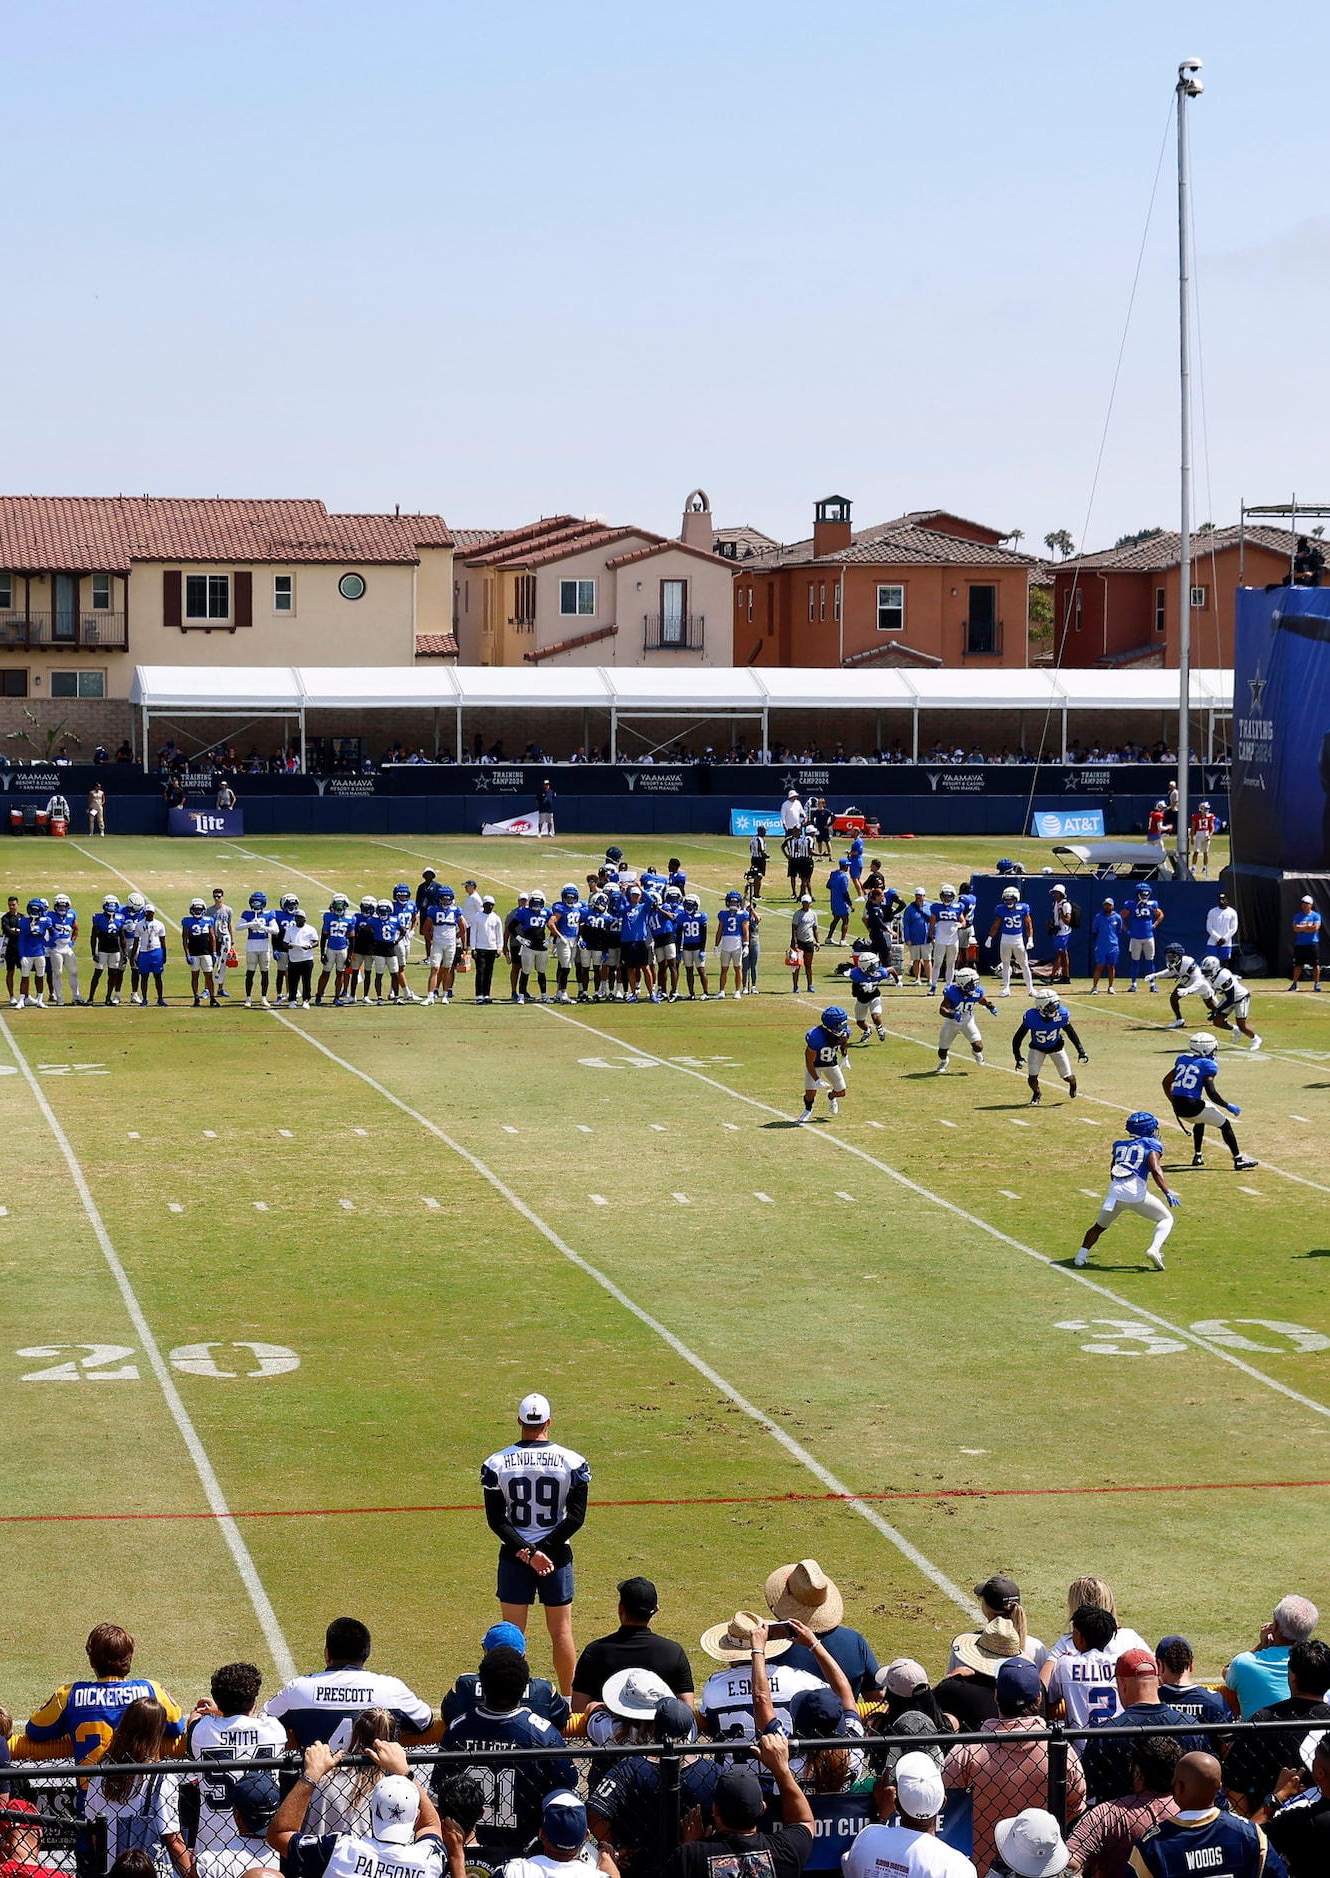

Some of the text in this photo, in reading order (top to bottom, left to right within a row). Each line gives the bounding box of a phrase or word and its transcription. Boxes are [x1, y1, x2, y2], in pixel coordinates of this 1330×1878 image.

[1239, 719, 1273, 740] TRAINING
[195, 816, 224, 834] Lite
[509, 822, 529, 833] WSS
[753, 818, 784, 829] invisal
[1064, 818, 1100, 831] AT&T
[1198, 819, 1208, 829] 13
[108, 924, 116, 933] 2
[330, 921, 348, 937] 25
[382, 925, 391, 940] 6
[683, 921, 700, 937] 38
[728, 917, 736, 932] 3
[1035, 1030, 1060, 1044] 54
[1173, 1064, 1199, 1090] 26
[17, 1342, 301, 1381] 20
[508, 1477, 560, 1528] 89
[1072, 1663, 1116, 1681] ELLIO
[316, 1686, 374, 1703] PRESCOTT
[728, 1678, 780, 1697] E.SH
[75, 1685, 150, 1707] DICKERSON
[220, 1731, 259, 1746] SMITH
[1185, 1846, 1223, 1870] WOODS
